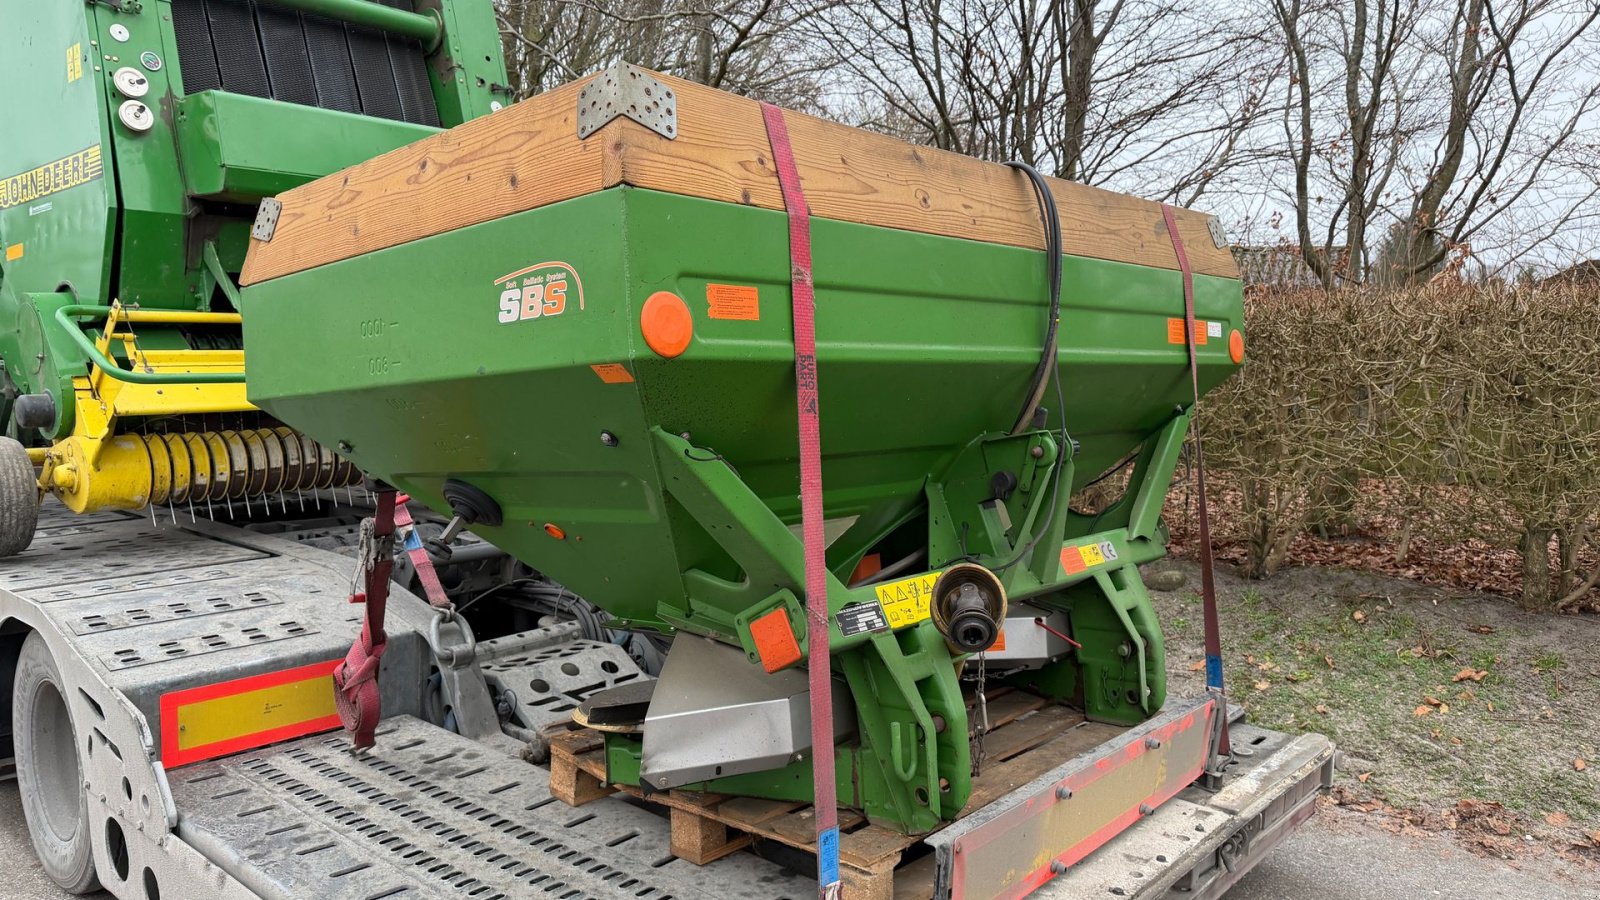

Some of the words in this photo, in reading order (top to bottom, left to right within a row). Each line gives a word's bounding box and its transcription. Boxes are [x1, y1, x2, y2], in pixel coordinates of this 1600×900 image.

[2, 170, 38, 206] JOHN
[43, 151, 89, 194] DEERE
[546, 271, 567, 283] System
[498, 280, 567, 324] SBS
[799, 354, 808, 390] PART
[806, 354, 816, 391] EURO
